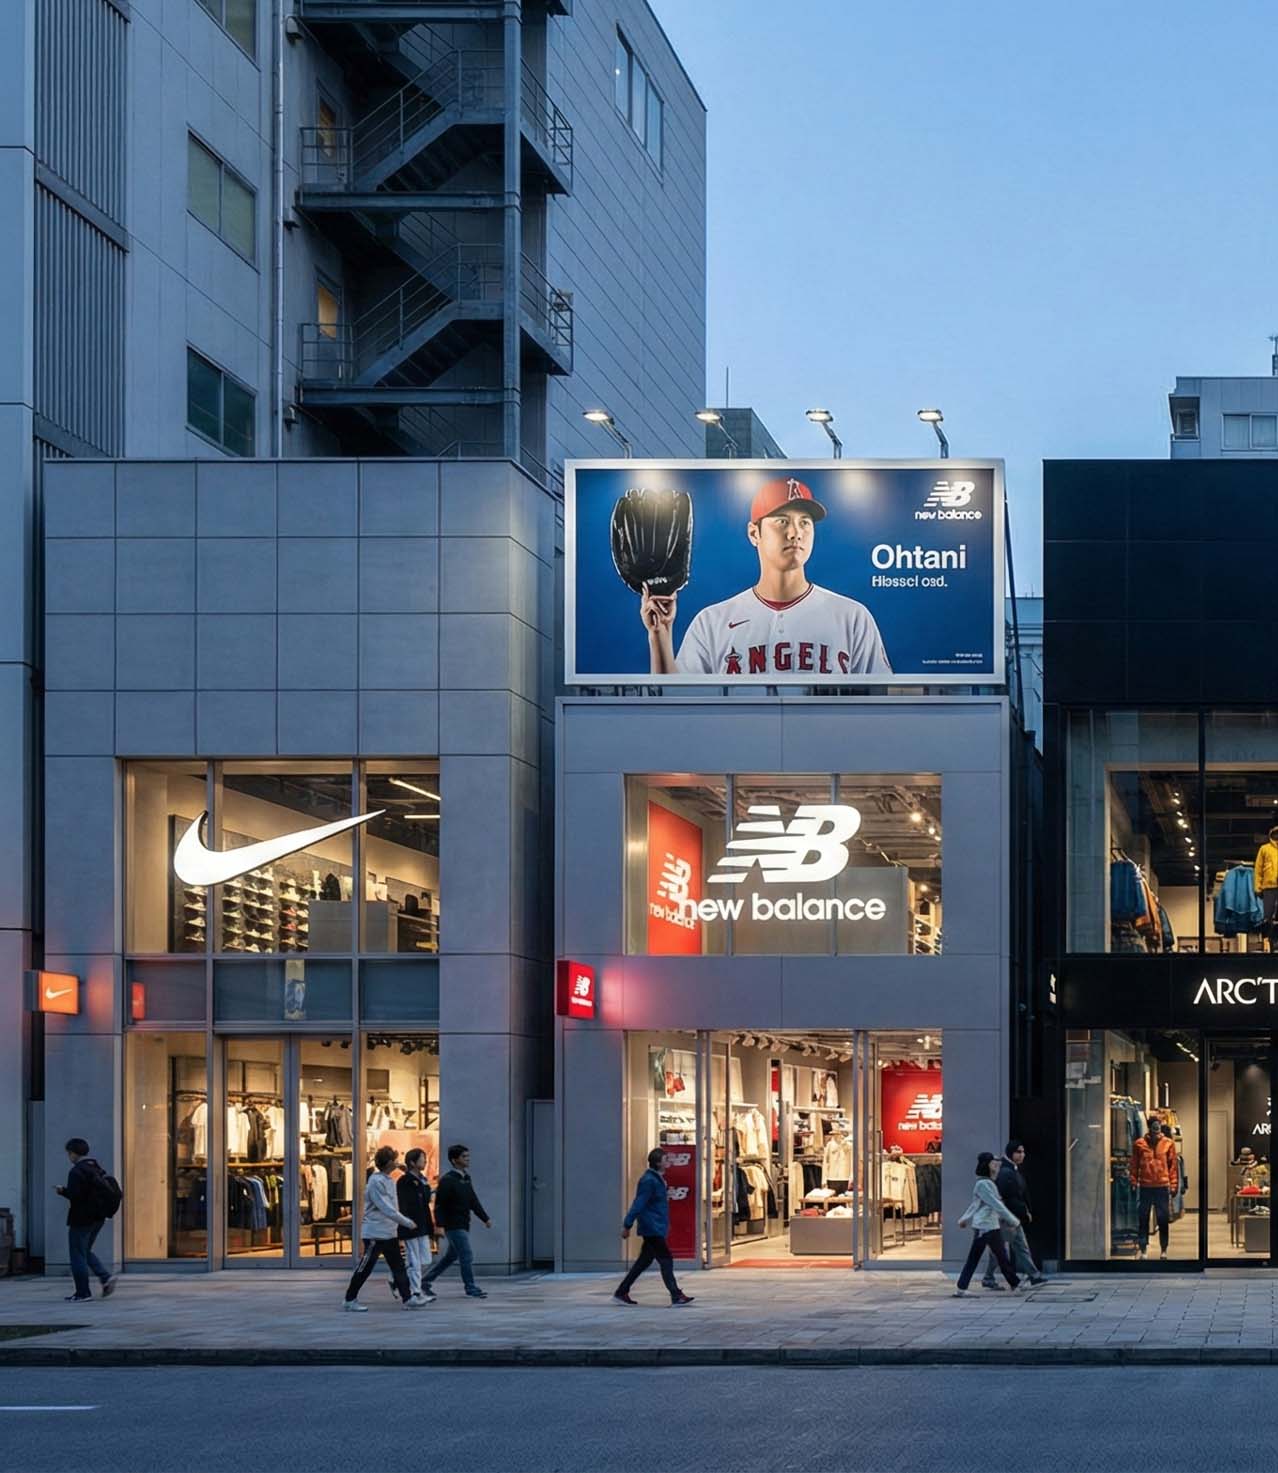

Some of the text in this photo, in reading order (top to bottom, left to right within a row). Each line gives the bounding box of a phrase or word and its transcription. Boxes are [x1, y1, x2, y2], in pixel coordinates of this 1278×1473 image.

[871, 544, 967, 570] Ohtani
[678, 898, 745, 921] new
[752, 892, 887, 921] balance
